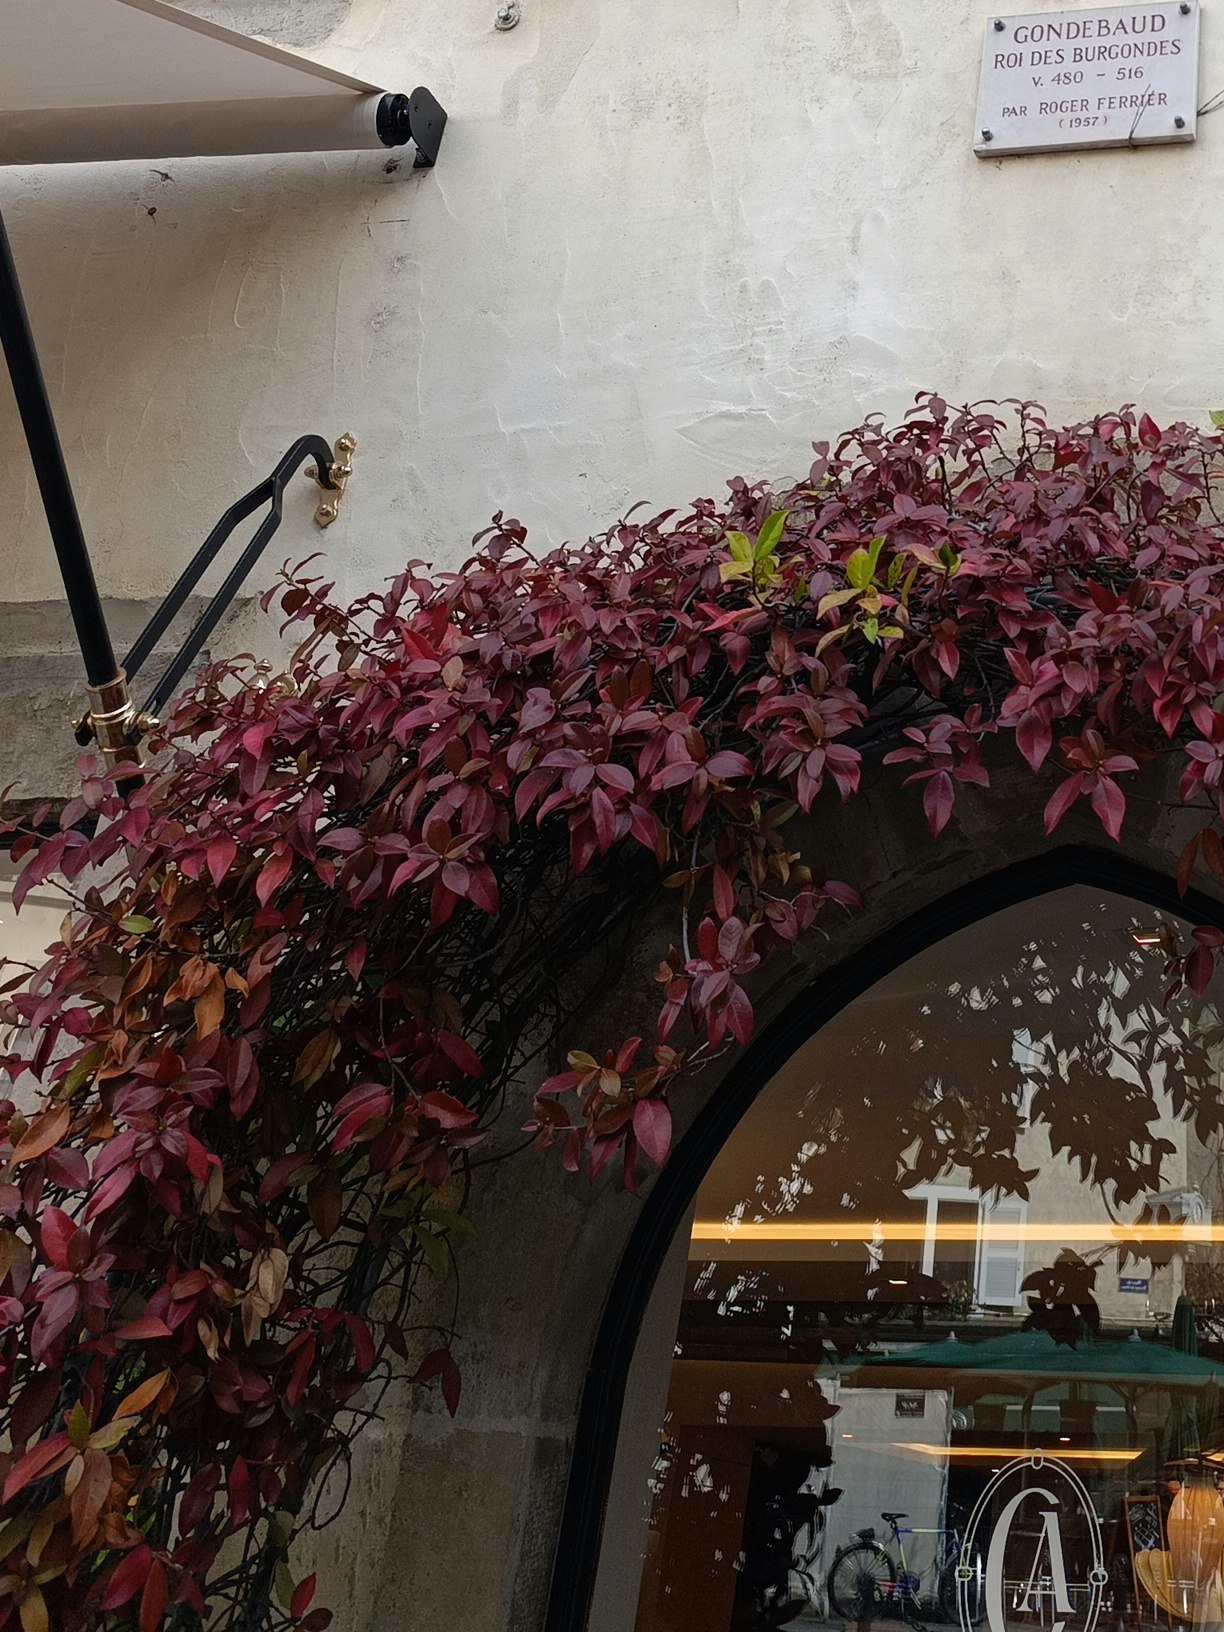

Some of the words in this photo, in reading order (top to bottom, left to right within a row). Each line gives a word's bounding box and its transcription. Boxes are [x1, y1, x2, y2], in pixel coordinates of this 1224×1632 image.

[1014, 14, 1166, 43] GONDEBAUD
[994, 51, 1023, 69] ROI
[1030, 49, 1065, 66] DES
[1073, 39, 1181, 63] BURGONDES
[1051, 71, 1084, 85] 480
[1116, 67, 1144, 80] 516
[1002, 106, 1027, 117] PAR
[1039, 99, 1089, 114] ROGER
[1097, 93, 1168, 110] FERRIER
[1059, 116, 1108, 128] (1957)
